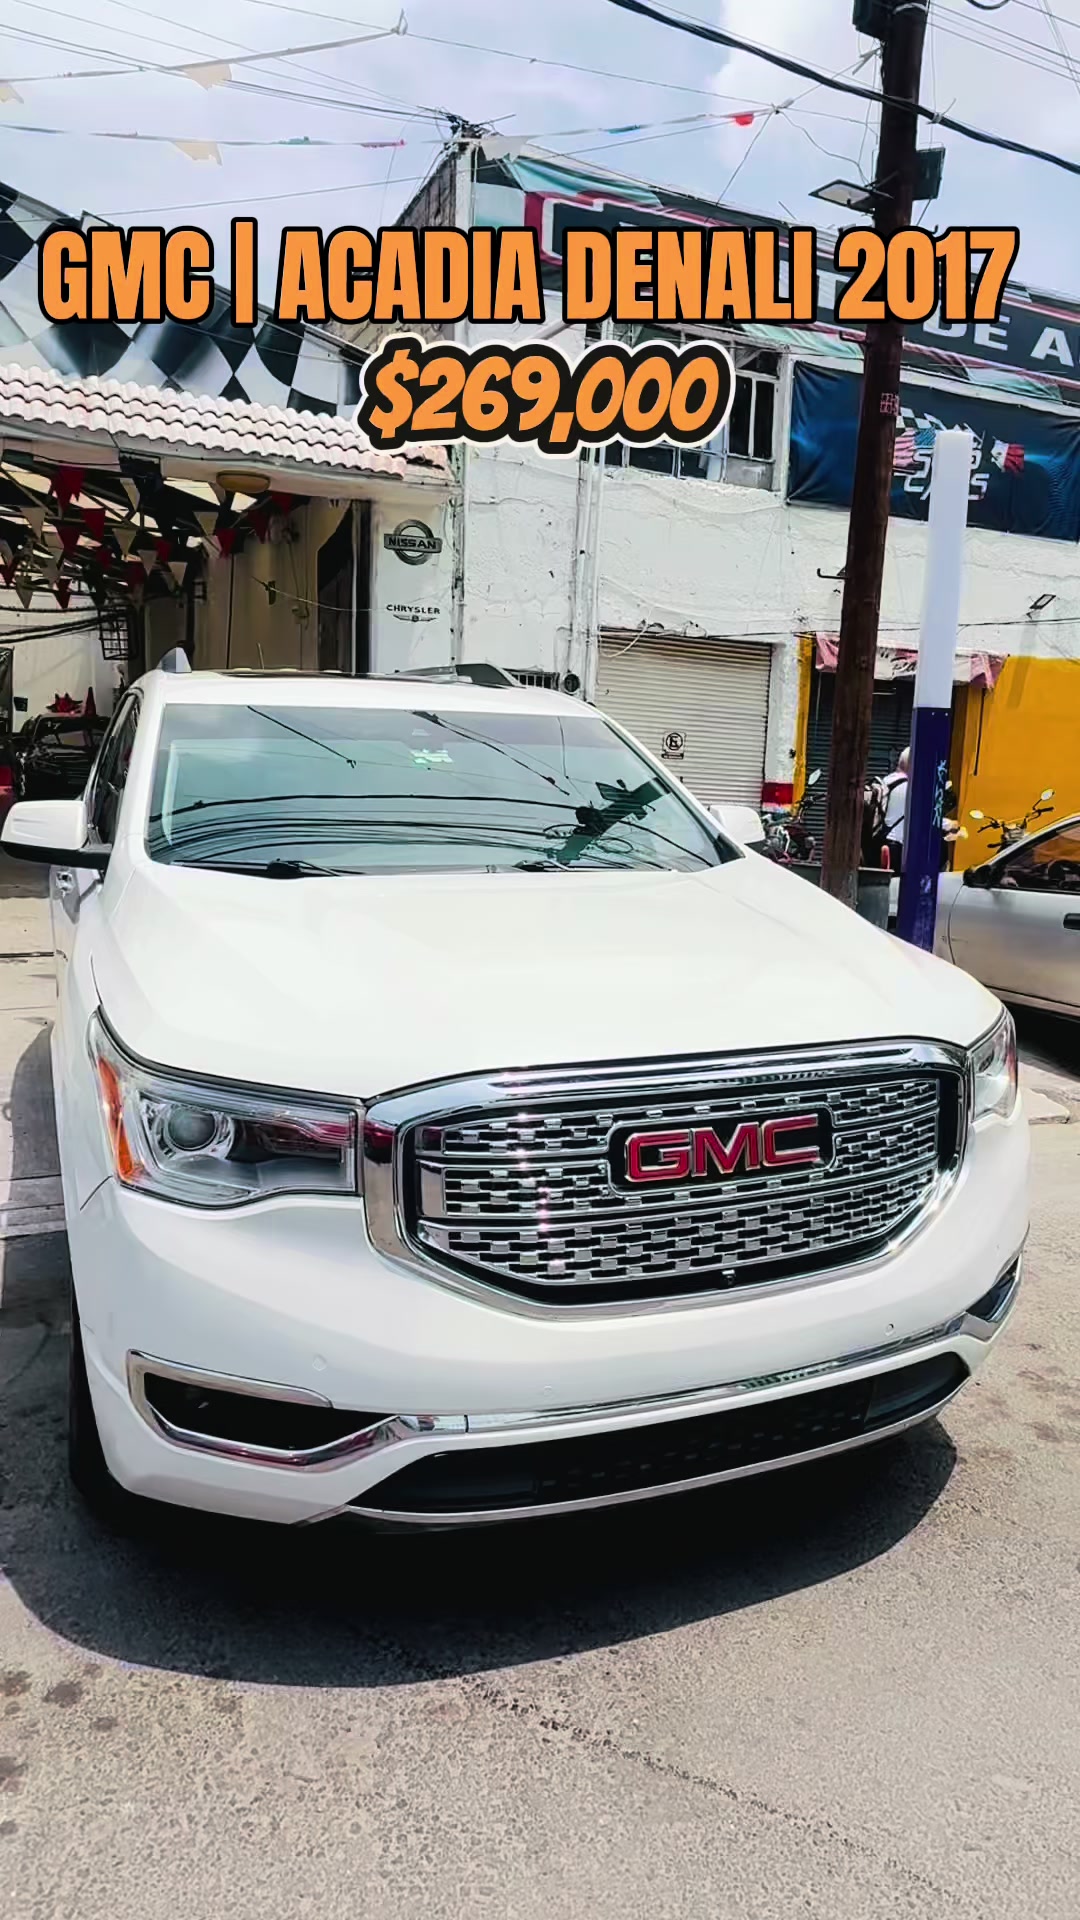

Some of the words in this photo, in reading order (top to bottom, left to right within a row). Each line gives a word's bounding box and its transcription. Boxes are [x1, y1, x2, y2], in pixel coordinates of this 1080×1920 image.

[388, 535, 437, 550] NISSAN
[385, 603, 441, 615] CHRYSLER
[624, 1113, 820, 1183] GMC
